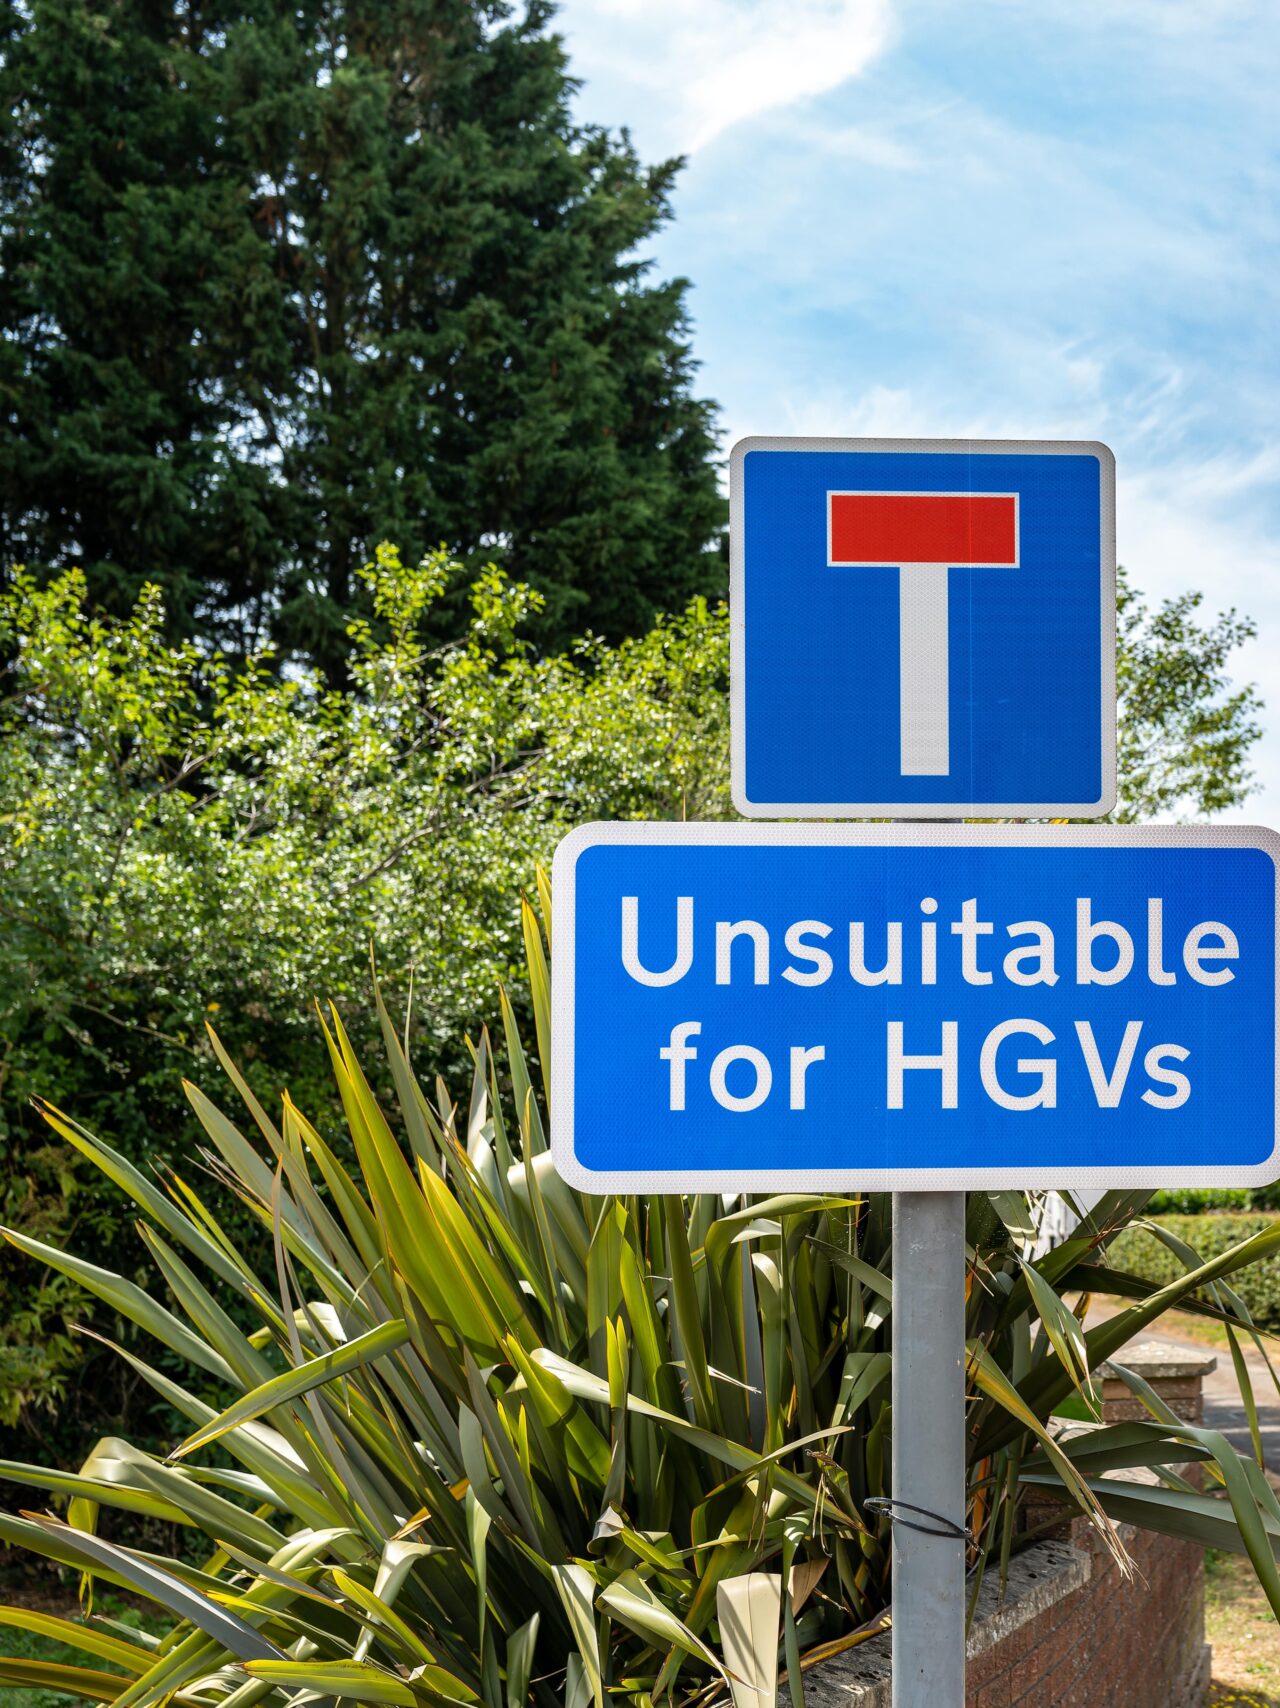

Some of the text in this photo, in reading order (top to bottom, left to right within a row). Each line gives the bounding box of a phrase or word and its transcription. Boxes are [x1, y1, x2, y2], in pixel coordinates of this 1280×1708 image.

[621, 896, 1240, 988] Unsuitable
[659, 1018, 1191, 1112] for HGVs
